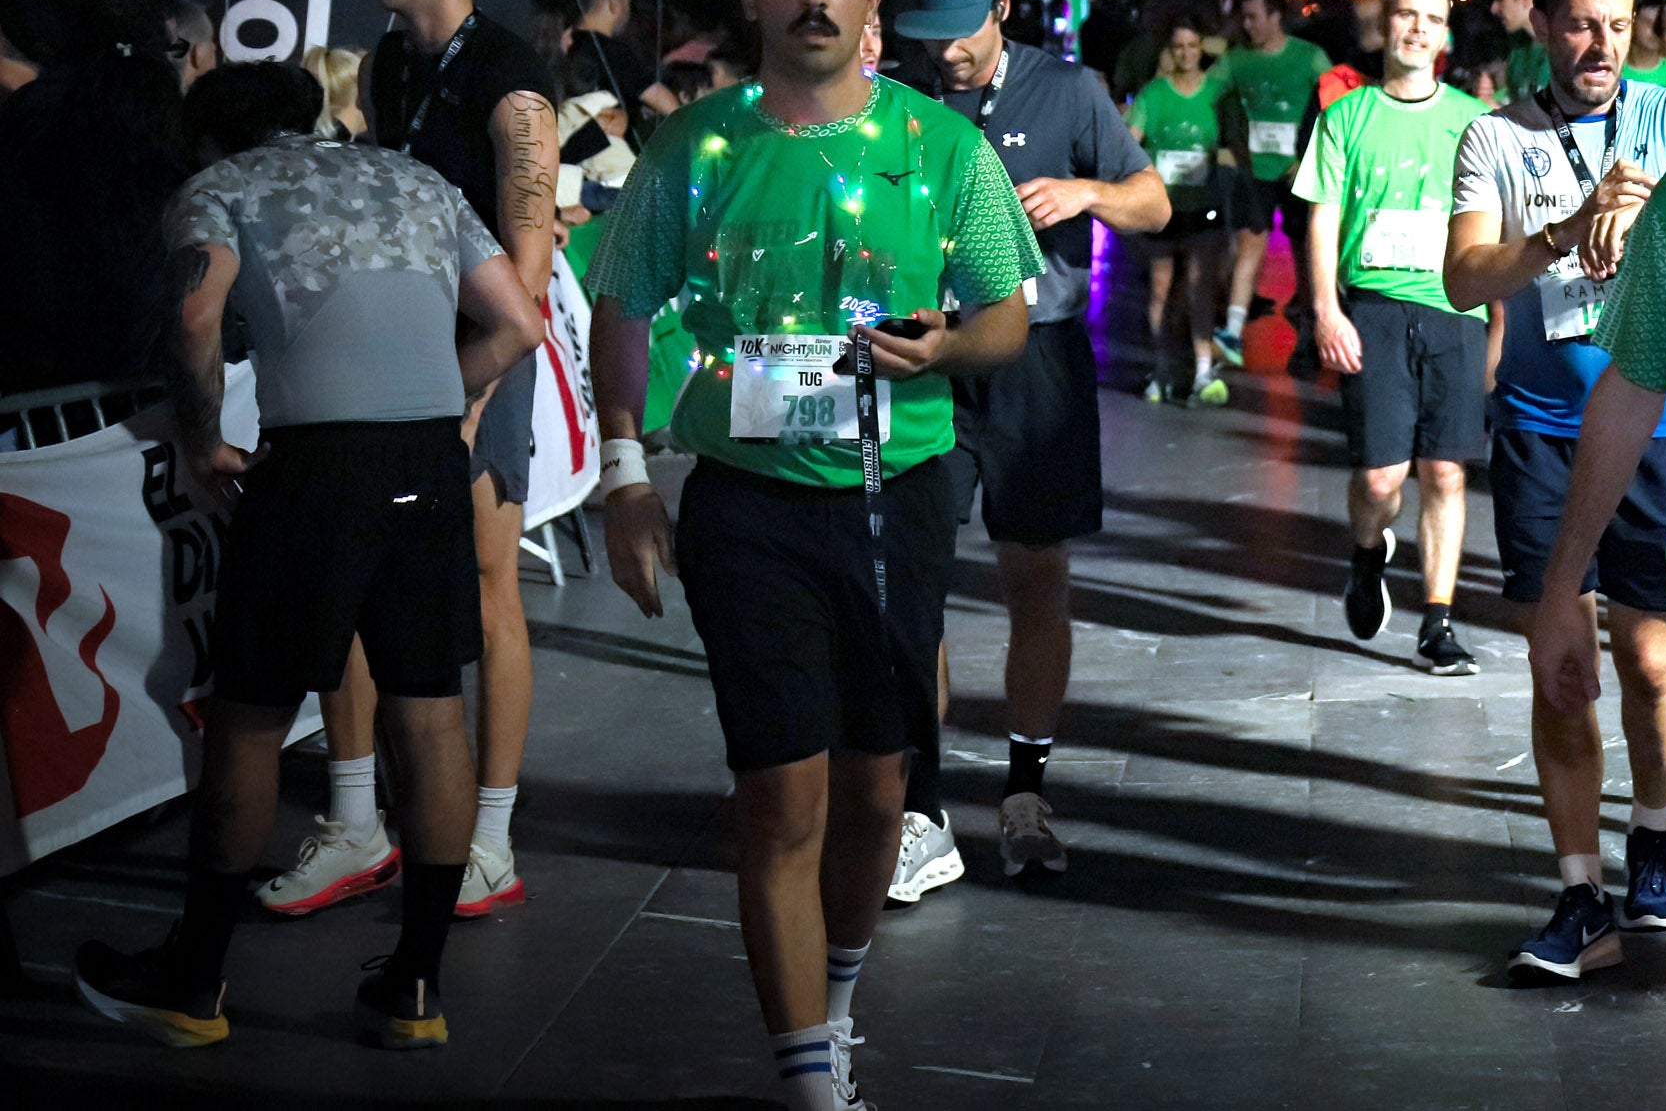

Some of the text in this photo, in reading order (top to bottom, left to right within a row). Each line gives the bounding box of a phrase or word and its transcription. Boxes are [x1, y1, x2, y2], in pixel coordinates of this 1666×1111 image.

[838, 295, 880, 314] 2025
[740, 337, 765, 357] 10K
[798, 371, 823, 387] TUG
[782, 394, 836, 428] 798
[861, 438, 874, 492] FINISHER
